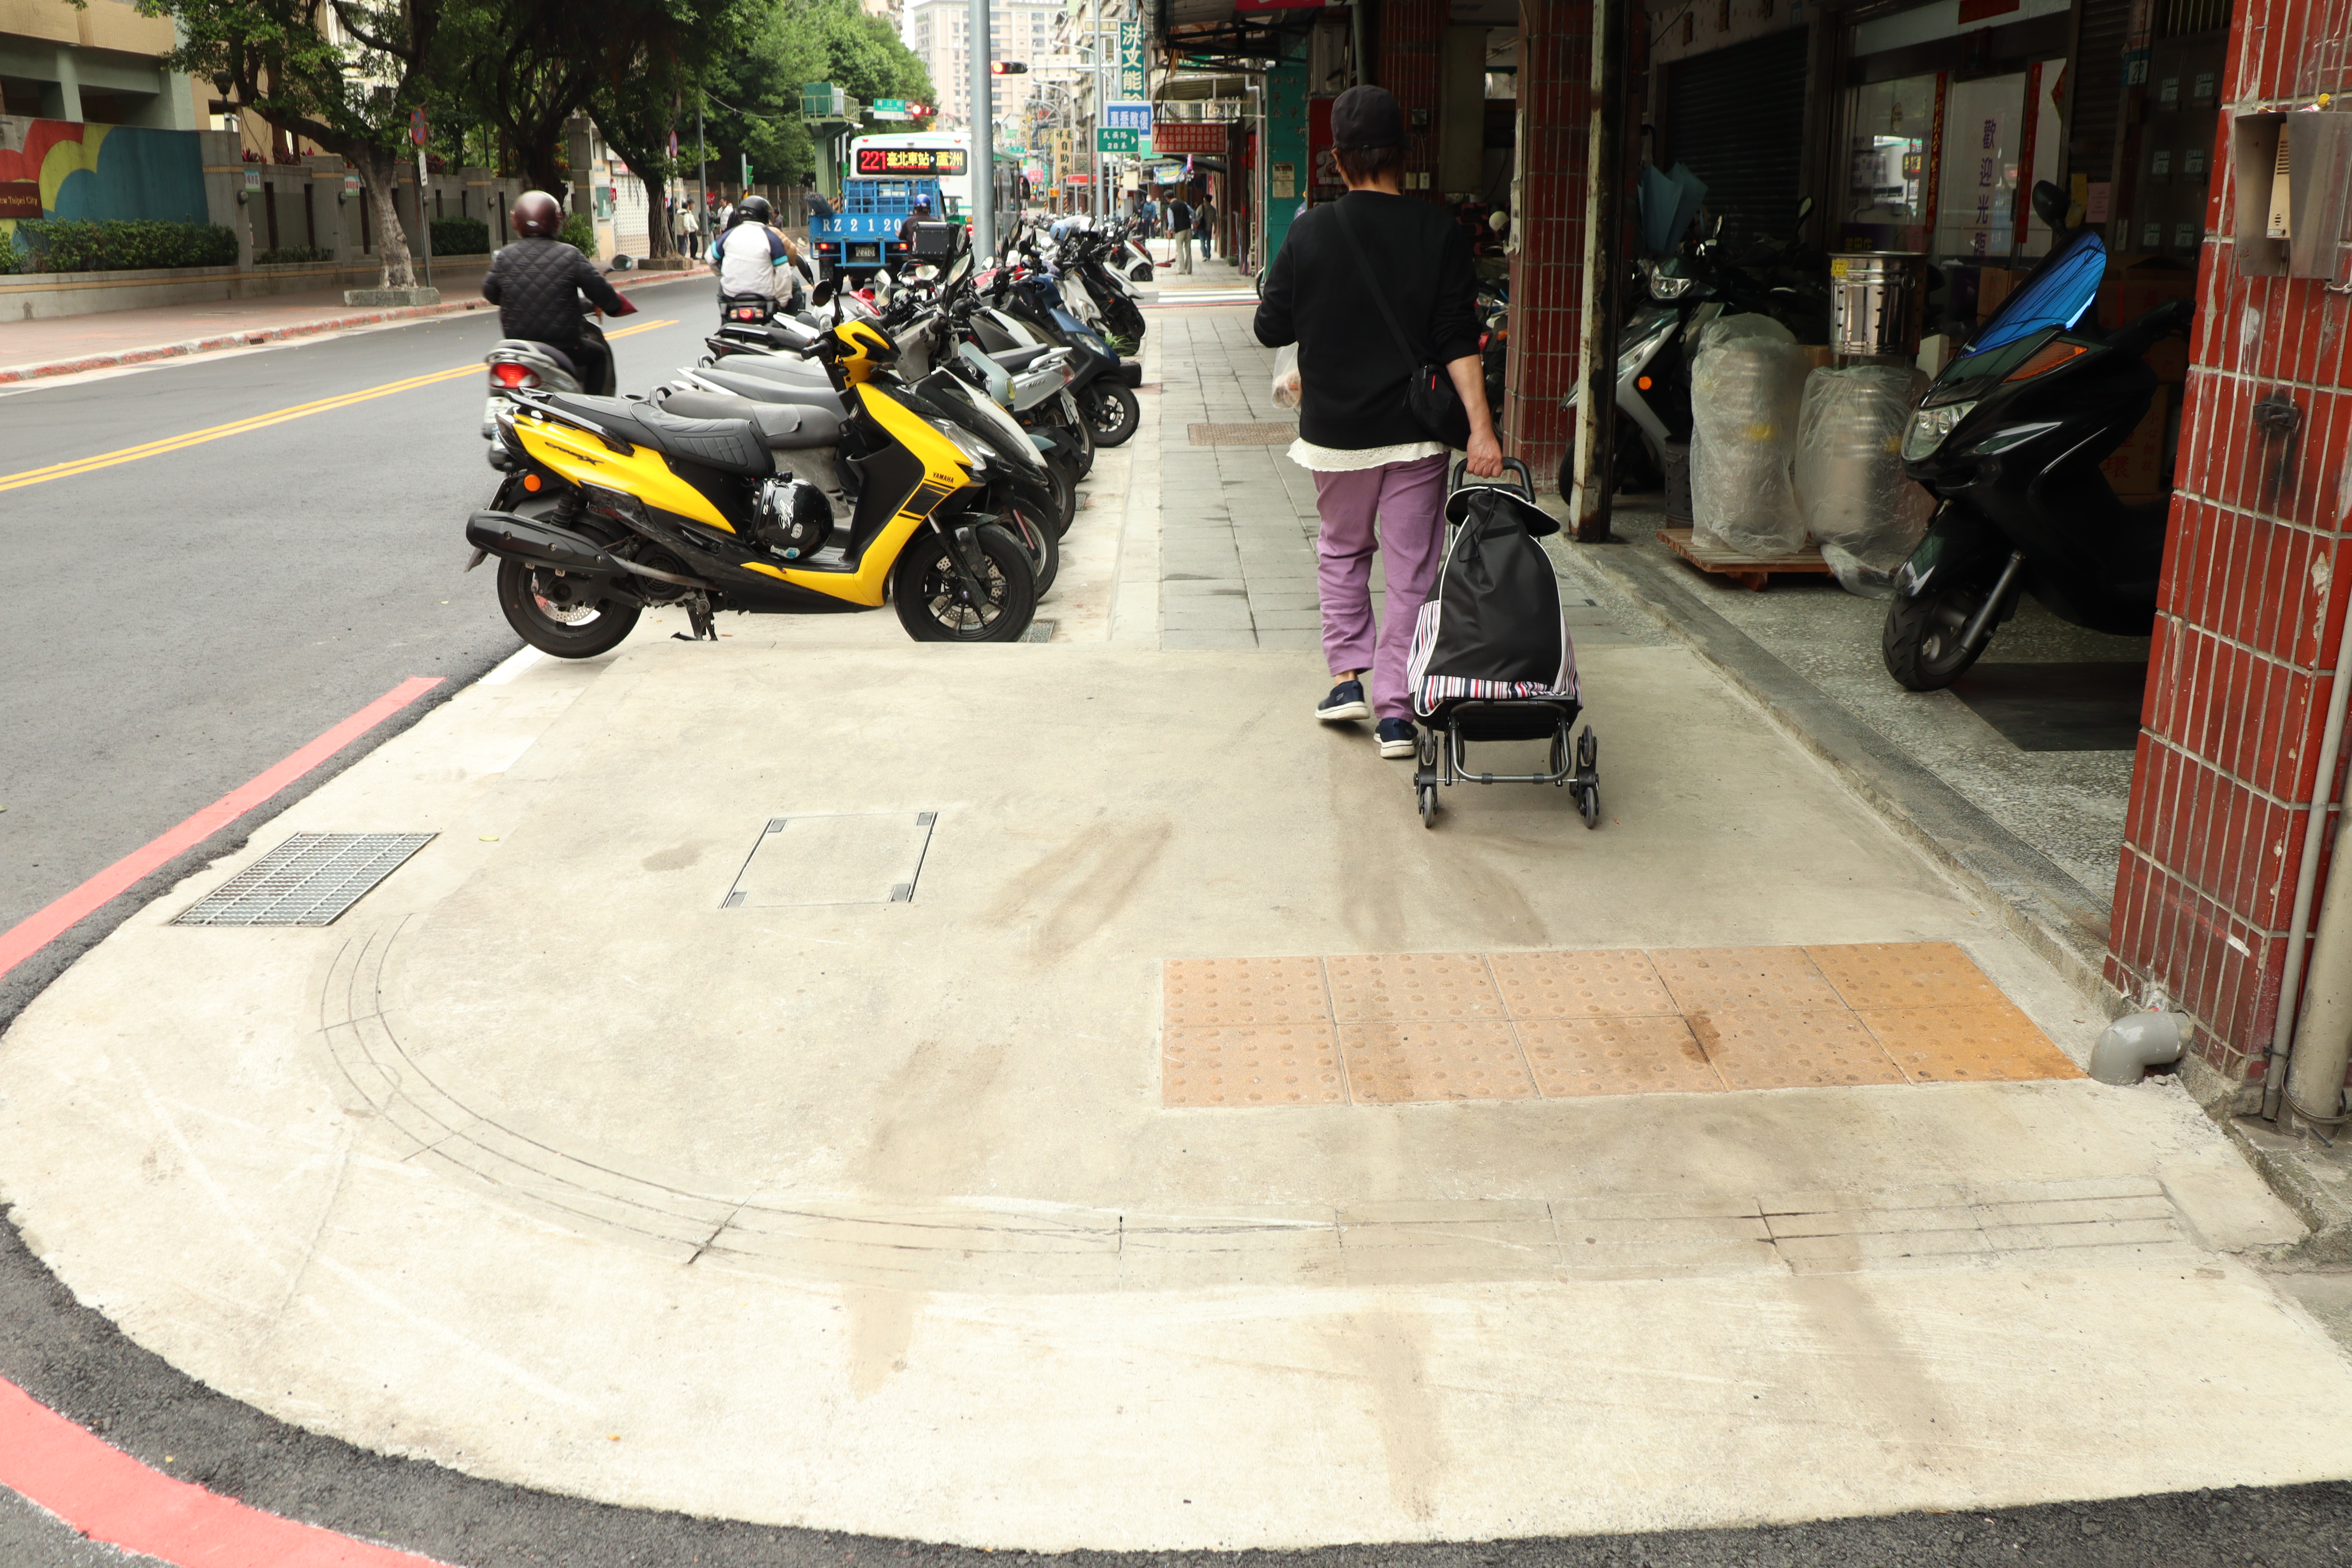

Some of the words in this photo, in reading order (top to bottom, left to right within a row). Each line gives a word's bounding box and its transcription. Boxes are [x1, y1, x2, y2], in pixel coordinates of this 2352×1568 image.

[860, 151, 887, 170] 221
[887, 151, 929, 166] 臺北車站
[936, 151, 963, 166] 蘆洲
[1973, 119, 1996, 261] 歡迎光臨
[8, 196, 25, 206] Taipei
[26, 196, 37, 206] City
[933, 472, 954, 483] YAMAHA
